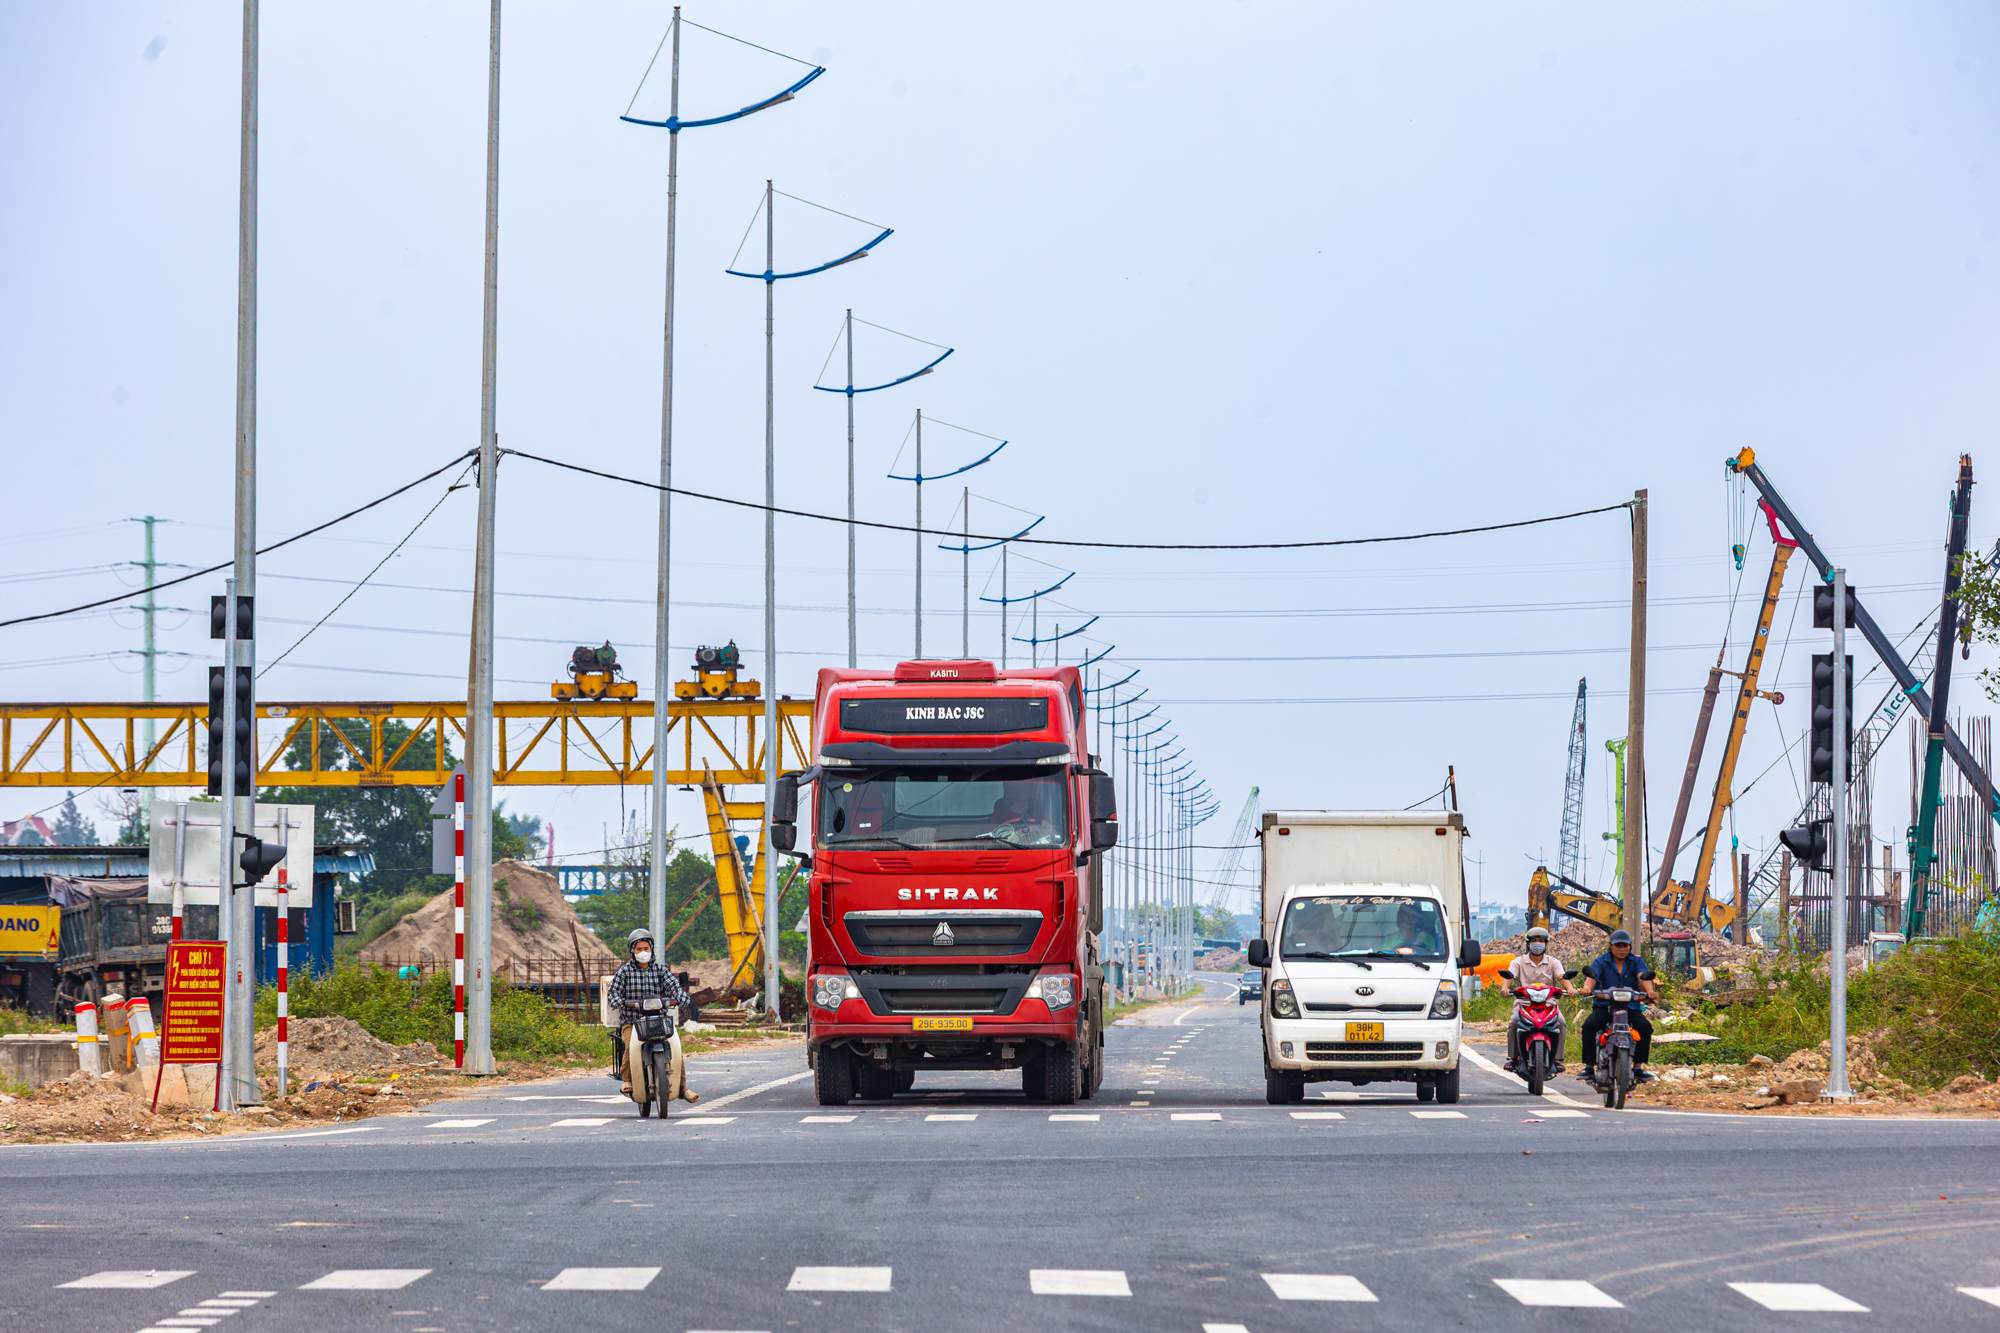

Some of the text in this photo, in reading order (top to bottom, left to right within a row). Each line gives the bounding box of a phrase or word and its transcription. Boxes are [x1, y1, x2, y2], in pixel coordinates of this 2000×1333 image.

[930, 669, 958, 678] KASITU
[906, 706, 985, 720] KINH BAC JSC
[898, 888, 998, 900] SITRAK
[1577, 900, 1588, 912] CAT
[189, 949, 202, 965] CHÚ
[1358, 987, 1372, 995] KIA
[917, 1019, 968, 1029] 29E-935.00
[1356, 1023, 1374, 1032] 98H
[1349, 1032, 1380, 1041] 011.42
